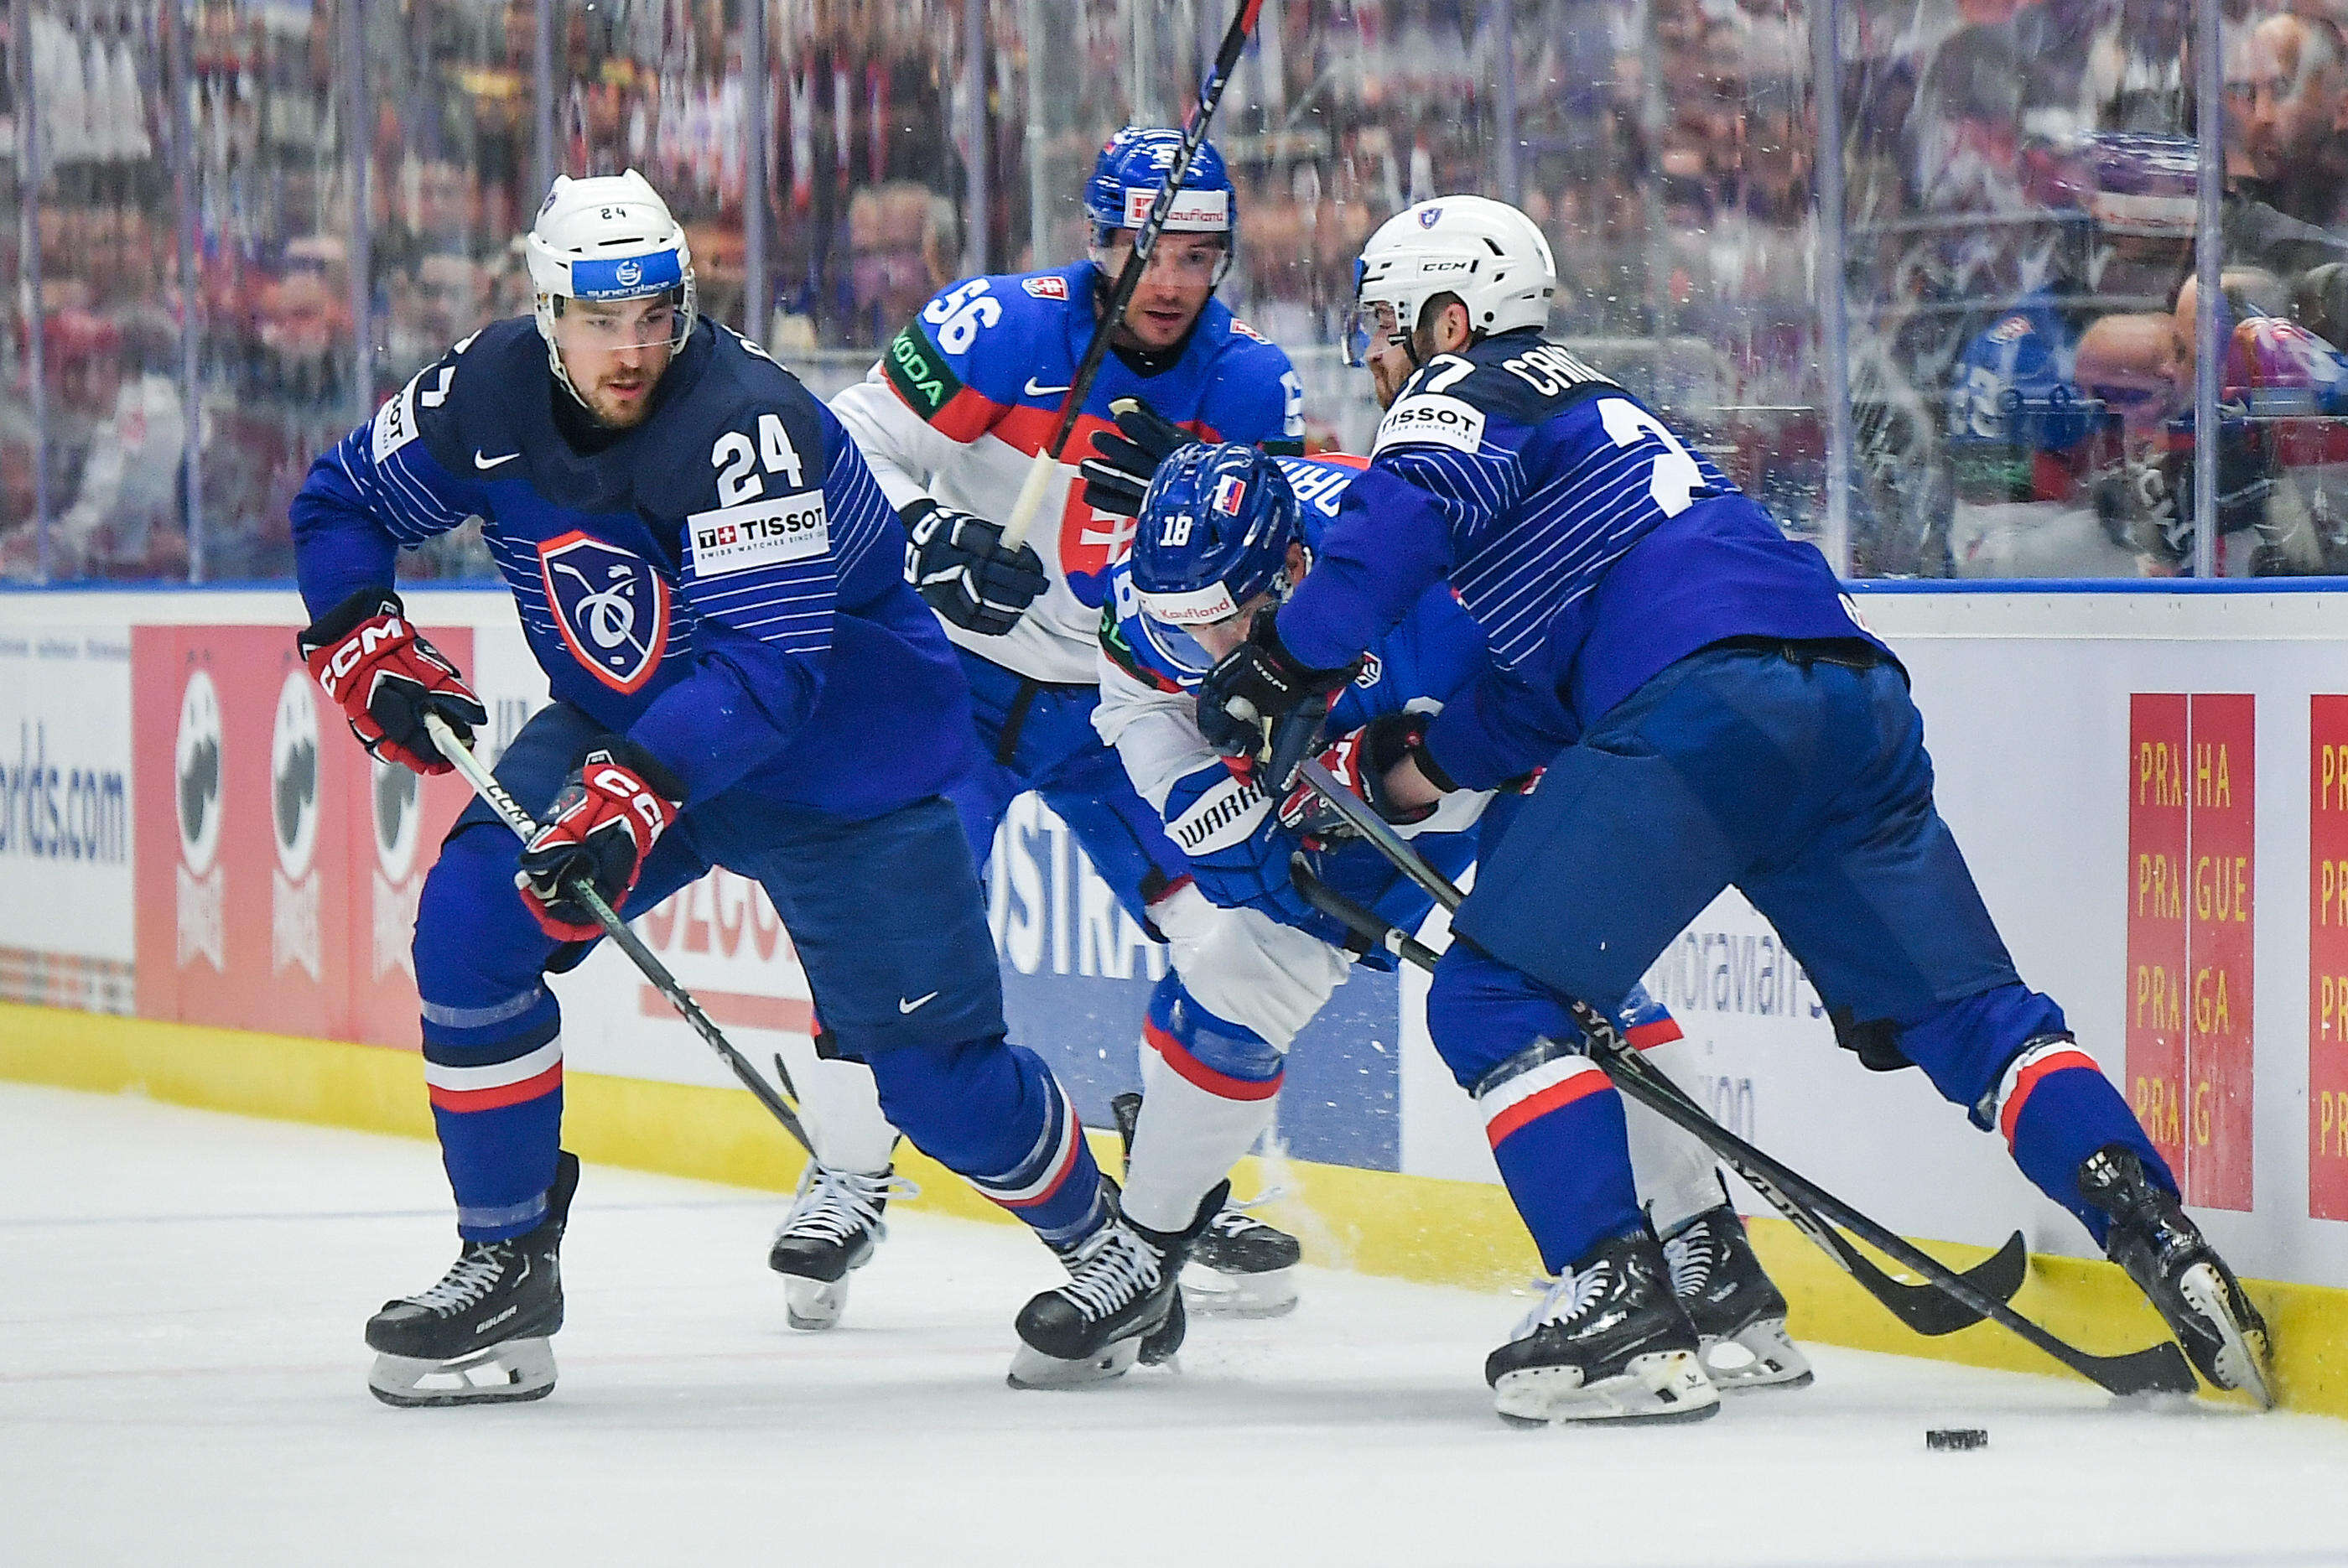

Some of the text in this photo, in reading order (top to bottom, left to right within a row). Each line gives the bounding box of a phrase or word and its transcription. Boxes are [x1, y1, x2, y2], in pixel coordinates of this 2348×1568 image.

[600, 207, 626, 220] 24
[1422, 262, 1468, 272] CCM
[922, 278, 1003, 355] 56
[711, 413, 803, 508] 24
[700, 547, 733, 560] SWISS
[738, 537, 785, 553] WATCHES
[740, 507, 823, 540] TISSOT
[1159, 516, 1192, 547] 18
[1159, 597, 1231, 620] Kaufland
[319, 618, 404, 698] CCM
[2322, 745, 2348, 812] PR
[2321, 859, 2348, 927] PR
[2320, 975, 2348, 1042] PR
[2320, 1091, 2348, 1158] PR
